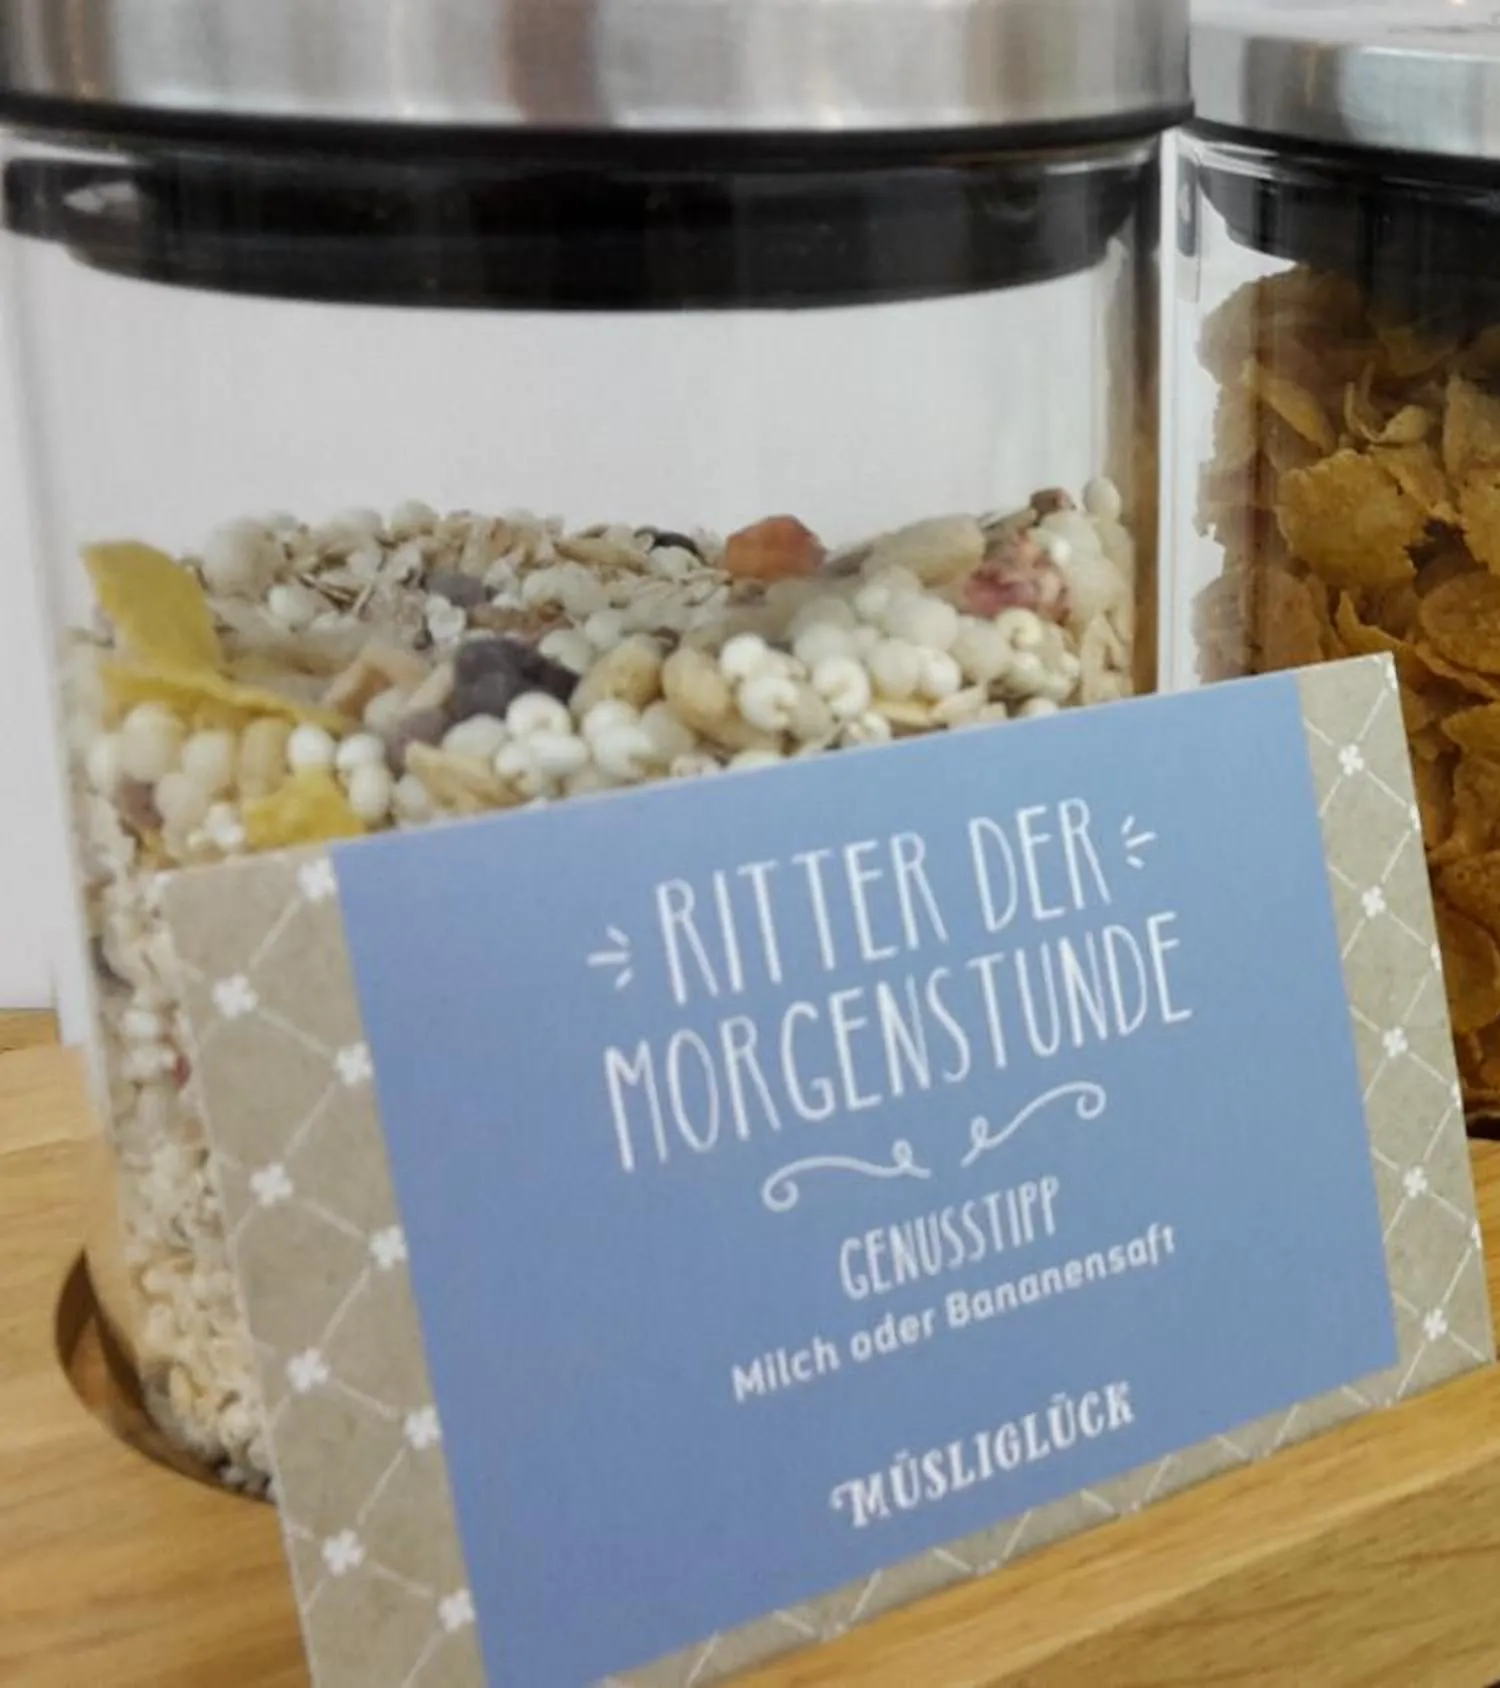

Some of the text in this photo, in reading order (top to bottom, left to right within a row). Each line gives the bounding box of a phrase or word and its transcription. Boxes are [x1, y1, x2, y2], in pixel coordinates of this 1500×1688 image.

[655, 797, 1112, 1006] RITTER DER
[603, 910, 1192, 1173] MORGENSTUNDE
[732, 1222, 1176, 1402] Milch oder Bananensaft
[838, 1174, 1060, 1301] GENUSSTIPP
[830, 1380, 1135, 1529] MÜSLIGLÜCK
